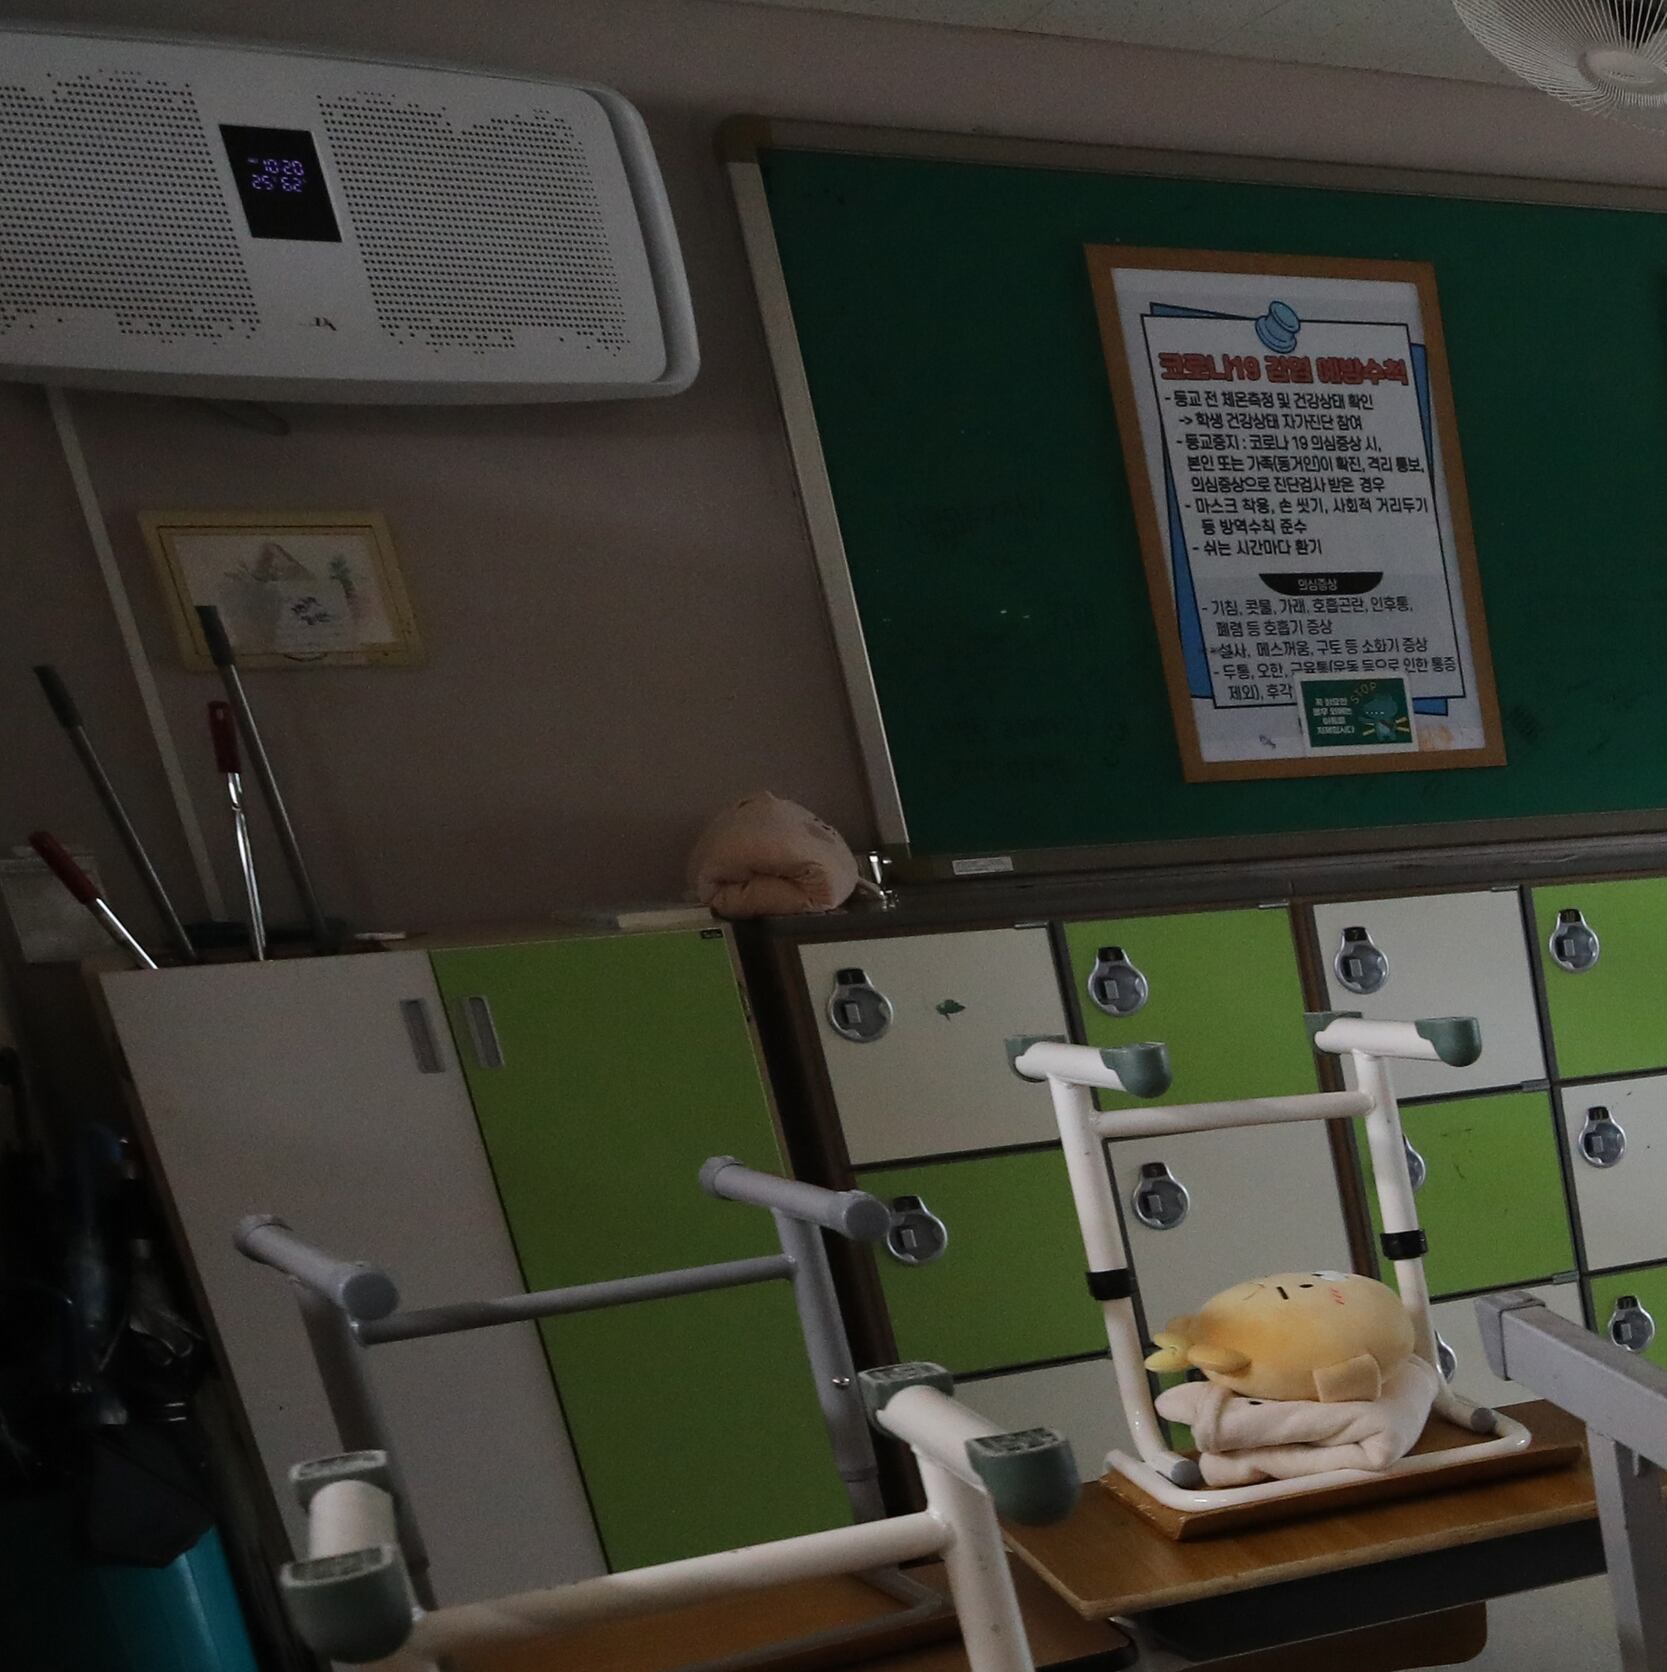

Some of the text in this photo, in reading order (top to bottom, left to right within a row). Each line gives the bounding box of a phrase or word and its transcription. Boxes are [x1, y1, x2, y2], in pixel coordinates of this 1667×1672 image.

[1174, 390, 1374, 410] 등교 전 체온측정 및 건강상태 확인
[1195, 412, 1363, 431] 학생 건강상태 자가진단 참여
[1249, 434, 1289, 450] 코로나
[1292, 435, 1308, 450] 19
[1310, 435, 1362, 452] 의심증상
[1365, 436, 1382, 452] 시,
[1187, 455, 1215, 472] 본인
[1218, 455, 1245, 472] 또는
[1335, 456, 1365, 473] 확진,
[1367, 456, 1393, 472] 격리
[1396, 456, 1425, 473] 통보,
[1191, 476, 1386, 493] 의심증상으로 진단검사 받은 경우
[1195, 497, 1428, 514] 마스크 착용, 손 씻기, 사회적 거리두기
[1202, 518, 1307, 536] 등 방역수칙 준수
[1204, 539, 1322, 556] 쉬는 시간마다 환기
[1297, 578, 1338, 591] 의심증상
[1211, 596, 1413, 616] 기침, 콧물, 가래, 호흡곤란, 인후통,
[1216, 619, 1333, 637] 폐렴 등 호흡기 증상
[1220, 637, 1428, 659] 설사, 메스꺼움, 구토 등 소화기 증상
[1223, 664, 1255, 680] 두통,
[1257, 663, 1288, 679] 오한,
[1403, 657, 1428, 673] 인한
[1431, 657, 1456, 673] 통증
[1228, 683, 1293, 701] 제외), 후각
